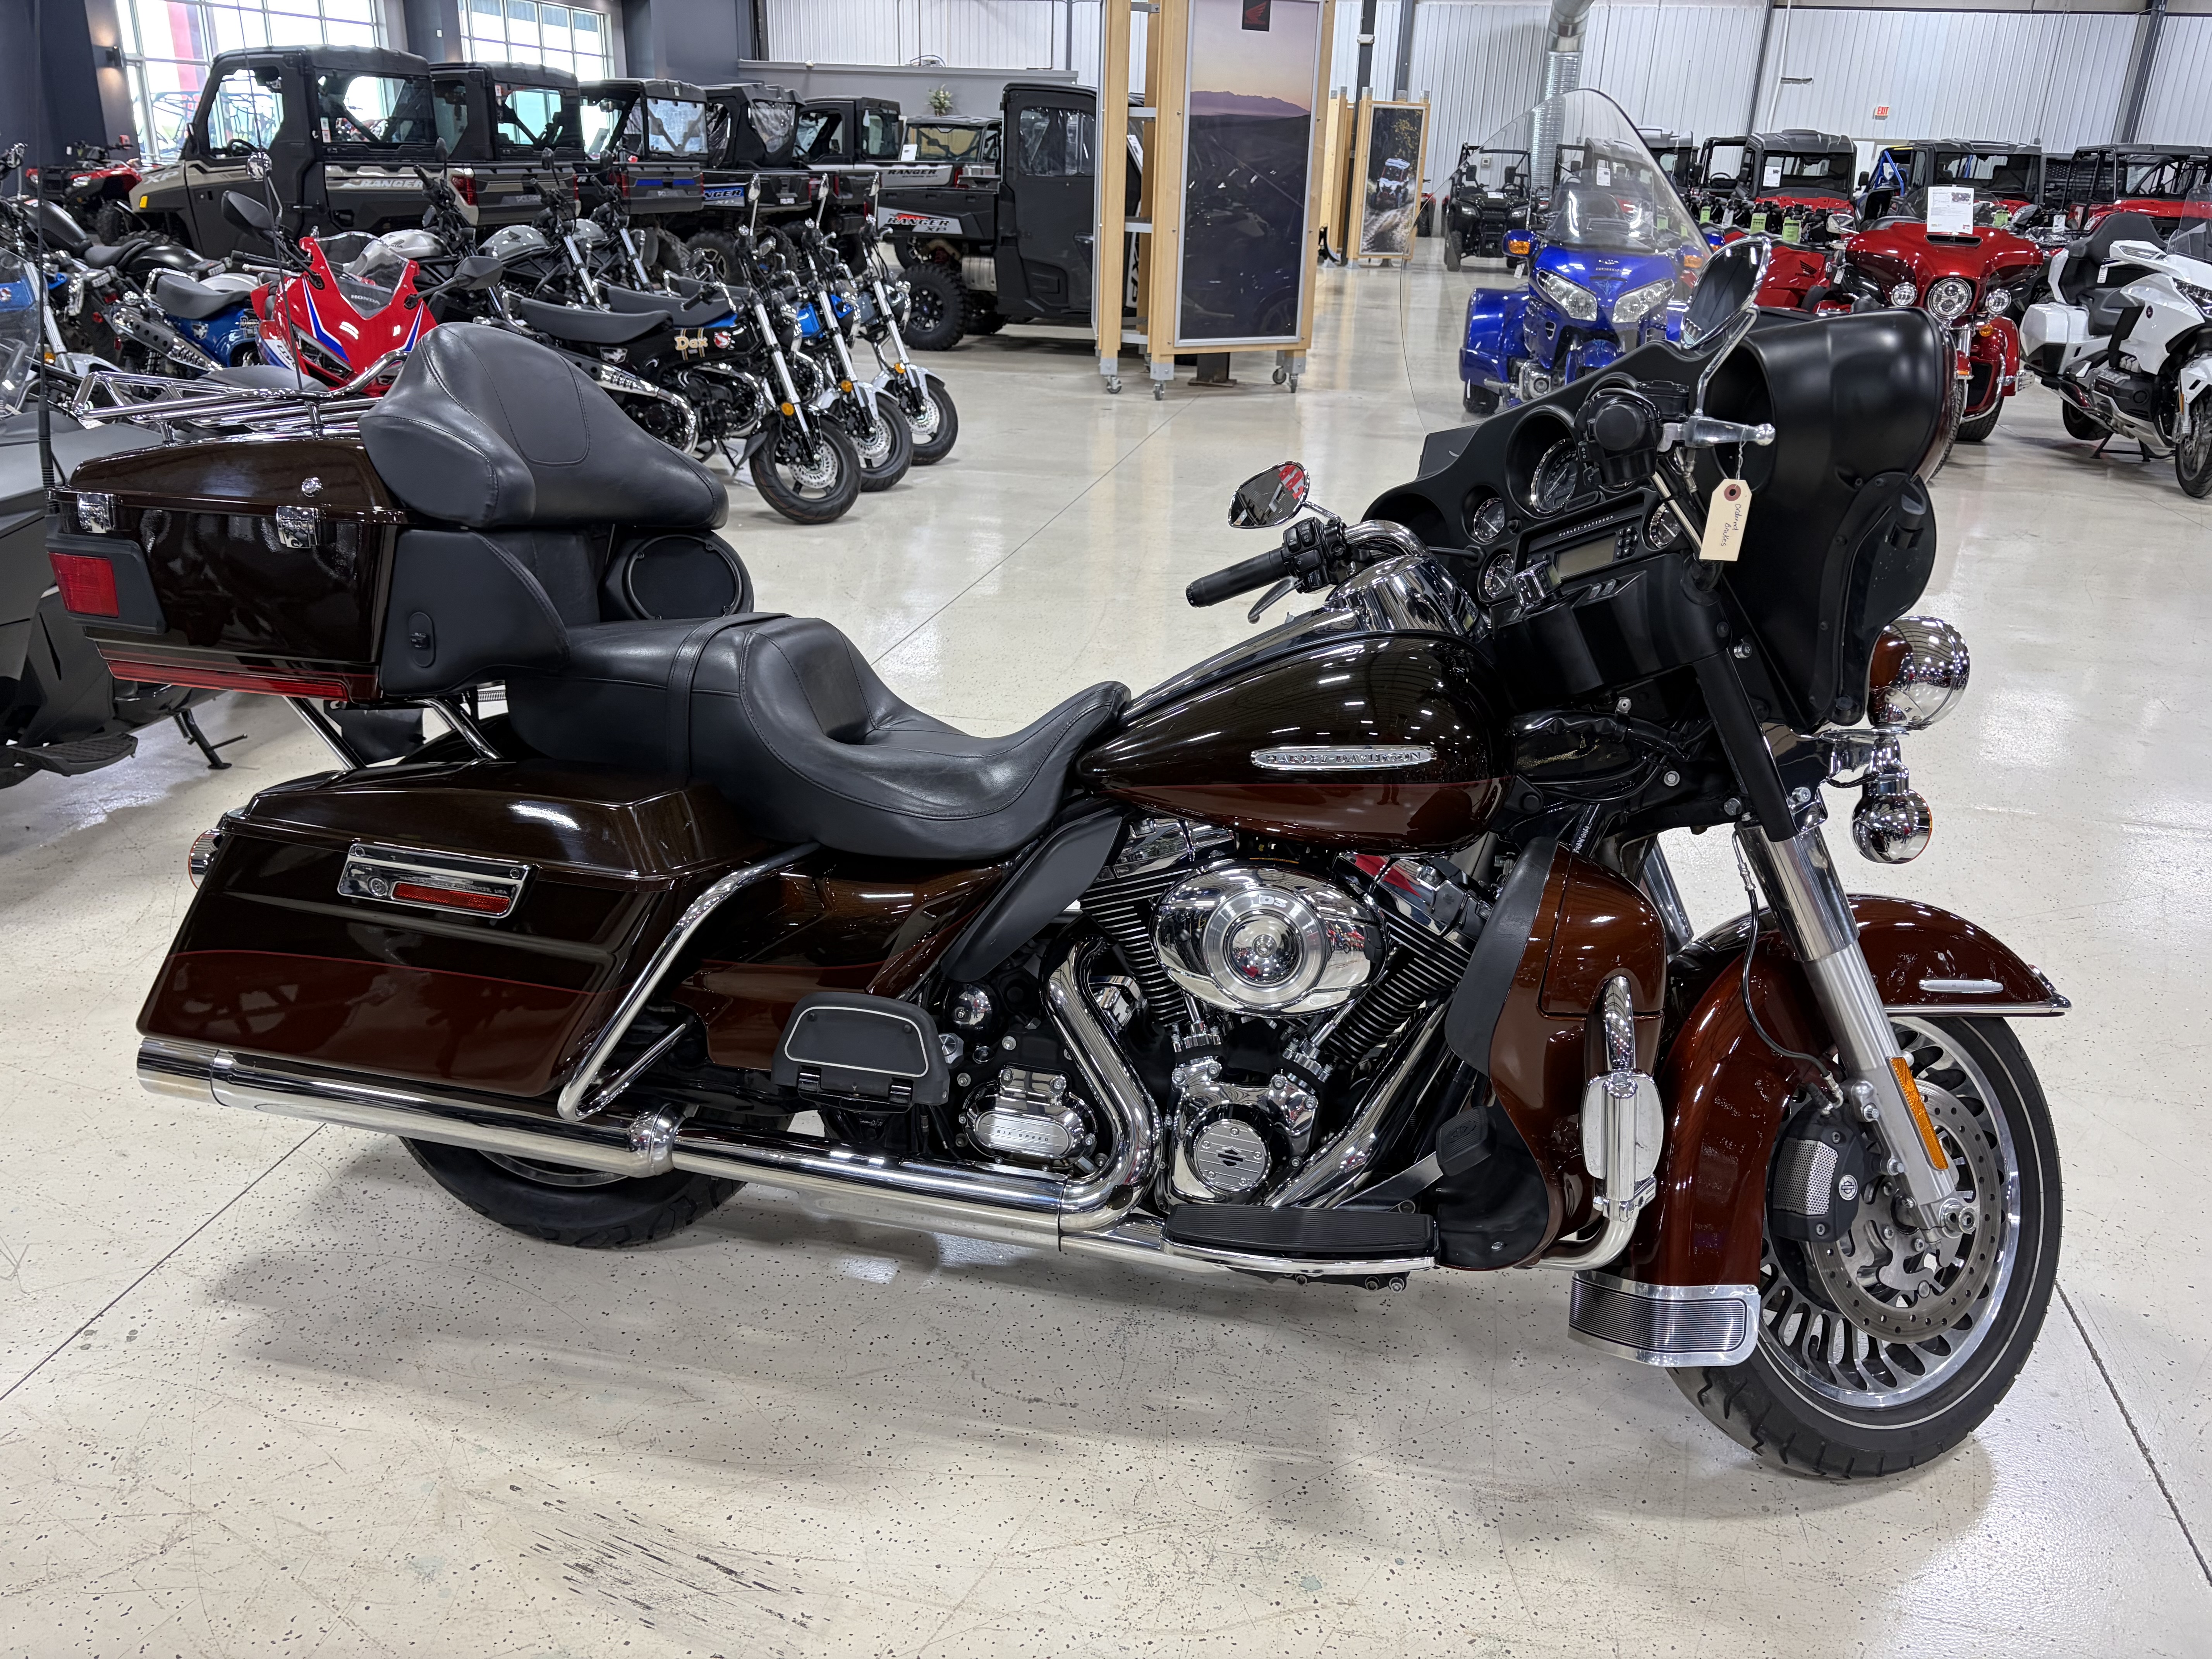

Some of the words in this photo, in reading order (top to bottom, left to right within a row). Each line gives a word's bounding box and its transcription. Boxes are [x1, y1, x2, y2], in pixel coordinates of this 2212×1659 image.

[1877, 106, 1889, 115] EXIT
[144, 171, 179, 184] XP
[704, 189, 741, 198] NGER
[887, 217, 950, 227] RANGER
[350, 294, 381, 305] HONDA
[674, 335, 709, 351] Dax
[1559, 515, 1614, 537] HARLEY-DAVIDSON
[1266, 751, 1422, 763] HARLEY-DAVIDSON
[1018, 1133, 1049, 1142] SPEED
